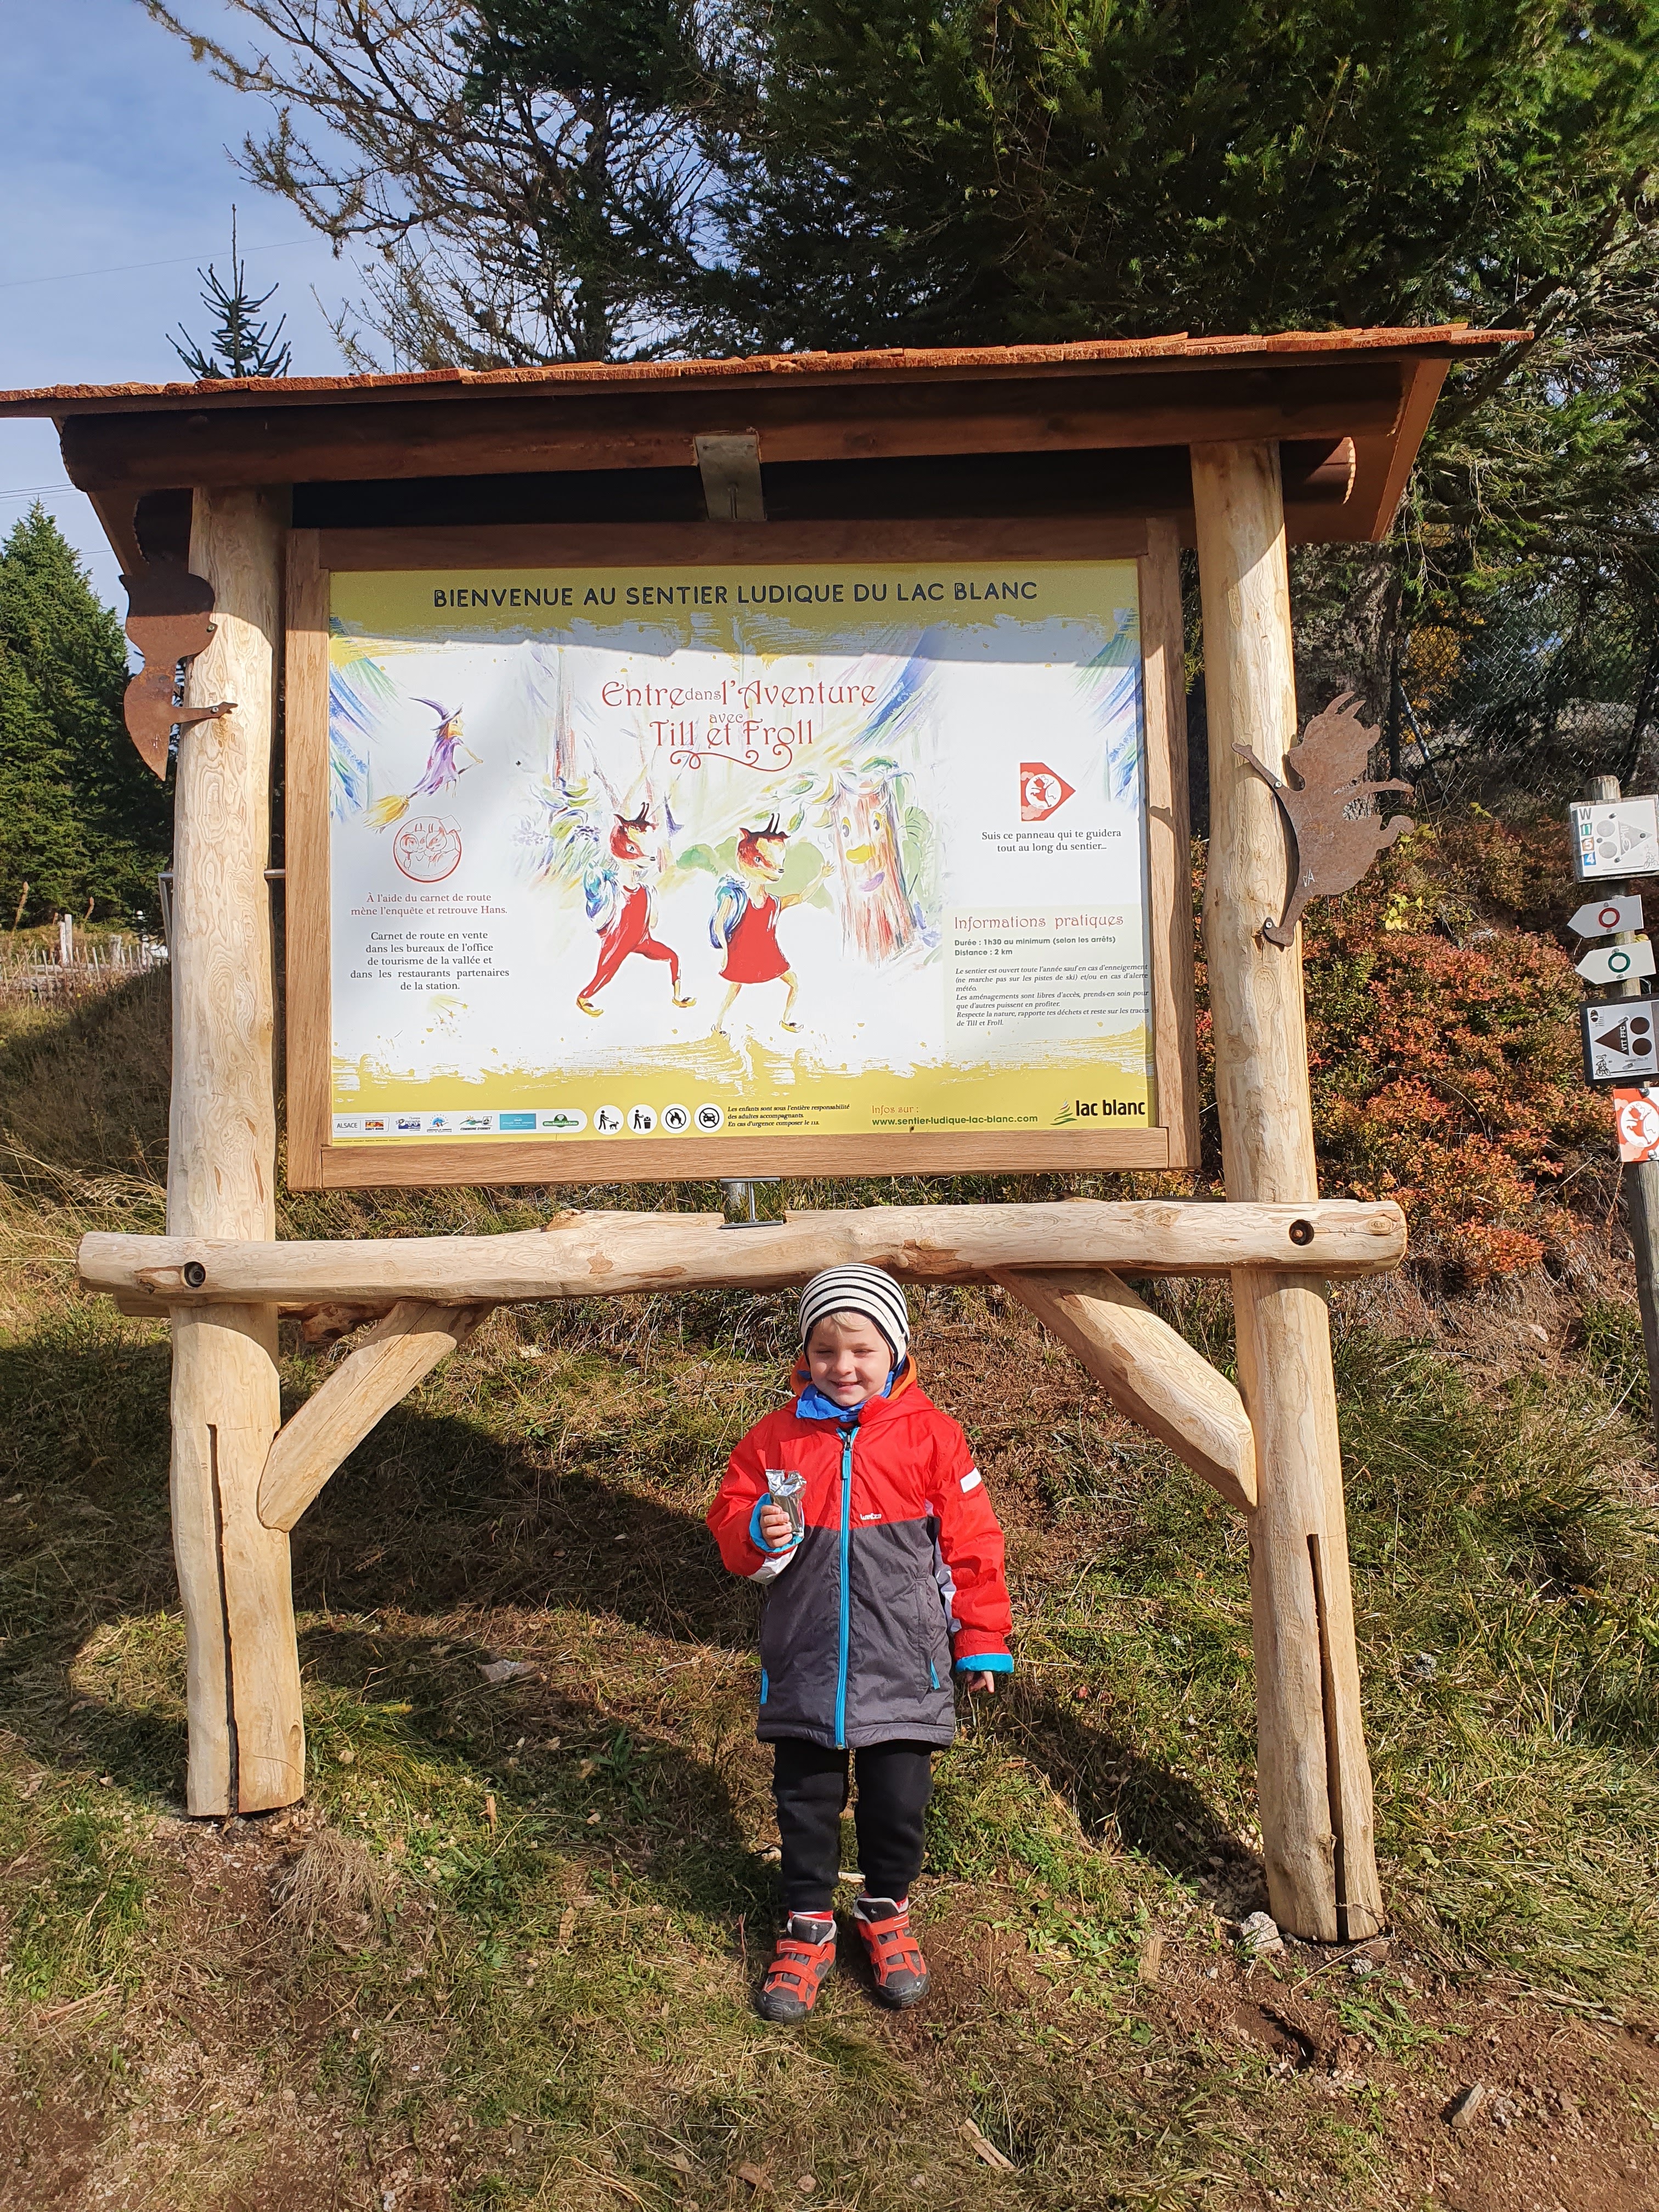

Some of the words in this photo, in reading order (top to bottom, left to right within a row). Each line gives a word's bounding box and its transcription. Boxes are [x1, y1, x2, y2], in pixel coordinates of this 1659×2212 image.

[435, 588, 572, 607] BIENVENUE
[584, 588, 615, 605] AU
[627, 586, 727, 605] SENTIER
[738, 585, 843, 603] LUDIQUE
[854, 584, 887, 601] DU
[898, 584, 944, 601] LAC
[955, 582, 1036, 600] BLANC
[602, 681, 686, 709] Entre
[685, 687, 721, 701] dans
[721, 680, 877, 709] l'Aventure
[709, 713, 744, 724] avec
[649, 719, 695, 746] Till
[707, 722, 731, 749] et
[743, 719, 813, 746] Froll
[1579, 808, 1592, 820] W
[1016, 833, 1054, 842] panneau
[1058, 830, 1071, 840] qui
[1086, 829, 1121, 840] guidera
[1032, 843, 1053, 854] long
[1583, 839, 1594, 849] 5
[1587, 854, 1595, 865] 4
[366, 892, 374, 902] À
[351, 907, 377, 915] mène
[381, 907, 423, 917] l'enquête
[955, 916, 1046, 932] Informations
[1055, 914, 1123, 930] pratiques
[382, 957, 424, 965] tourisme
[456, 969, 509, 979] partenaires
[1034, 975, 1052, 983] pistes
[426, 981, 460, 990] station.
[1083, 991, 1115, 999] prends-en
[872, 1105, 895, 1115] Infos
[1076, 1100, 1098, 1116] lac
[1103, 1099, 1146, 1115] blanc
[872, 1115, 1037, 1127] www.sentier-ludique-lac-blanc.com
